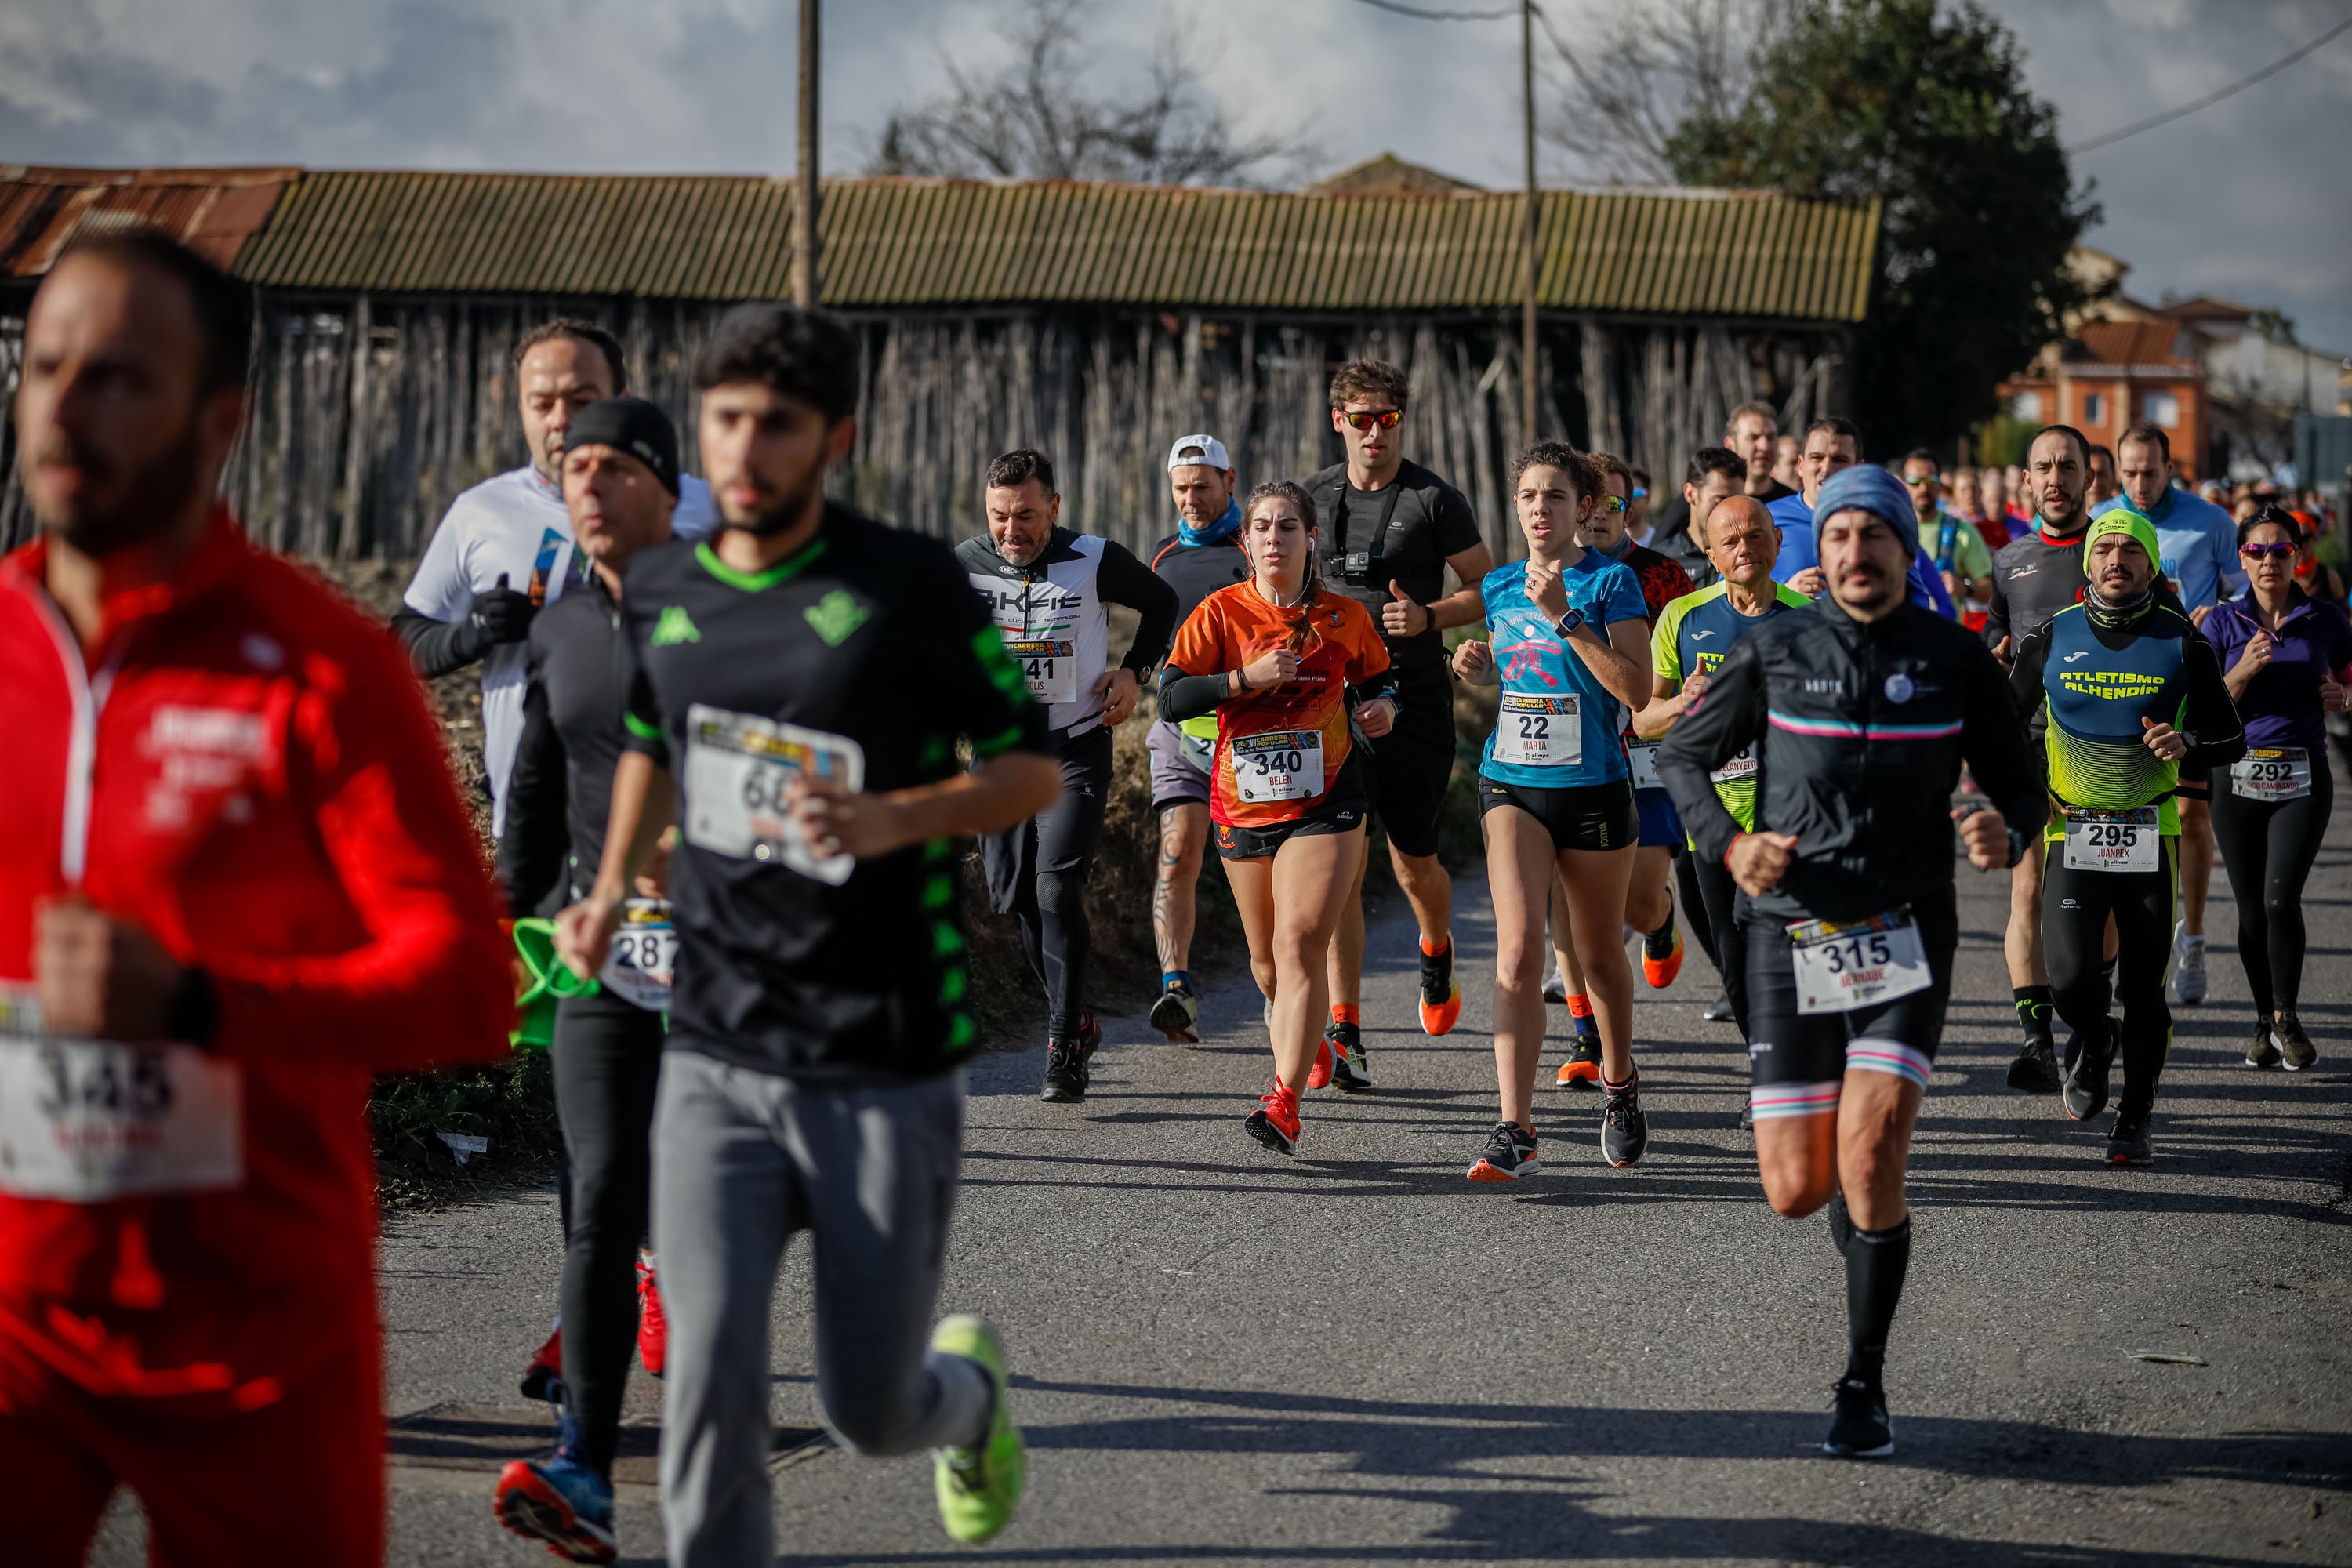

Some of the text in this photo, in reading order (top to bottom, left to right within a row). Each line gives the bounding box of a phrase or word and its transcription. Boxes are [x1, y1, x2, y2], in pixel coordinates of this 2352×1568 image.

[2060, 671, 2165, 684] ATLETISMO
[2064, 681, 2158, 700] ALHENDÍN
[1519, 715, 1550, 739] 22
[1257, 734, 1288, 742] CARRERA
[1523, 740, 1548, 751] MARTA
[1254, 750, 1302, 776] 340
[2250, 763, 2293, 781] 292
[1269, 775, 1293, 786] BELEN
[2088, 825, 2138, 848] 295
[2097, 848, 2130, 858] JUANPEX
[1822, 935, 1891, 974] 315
